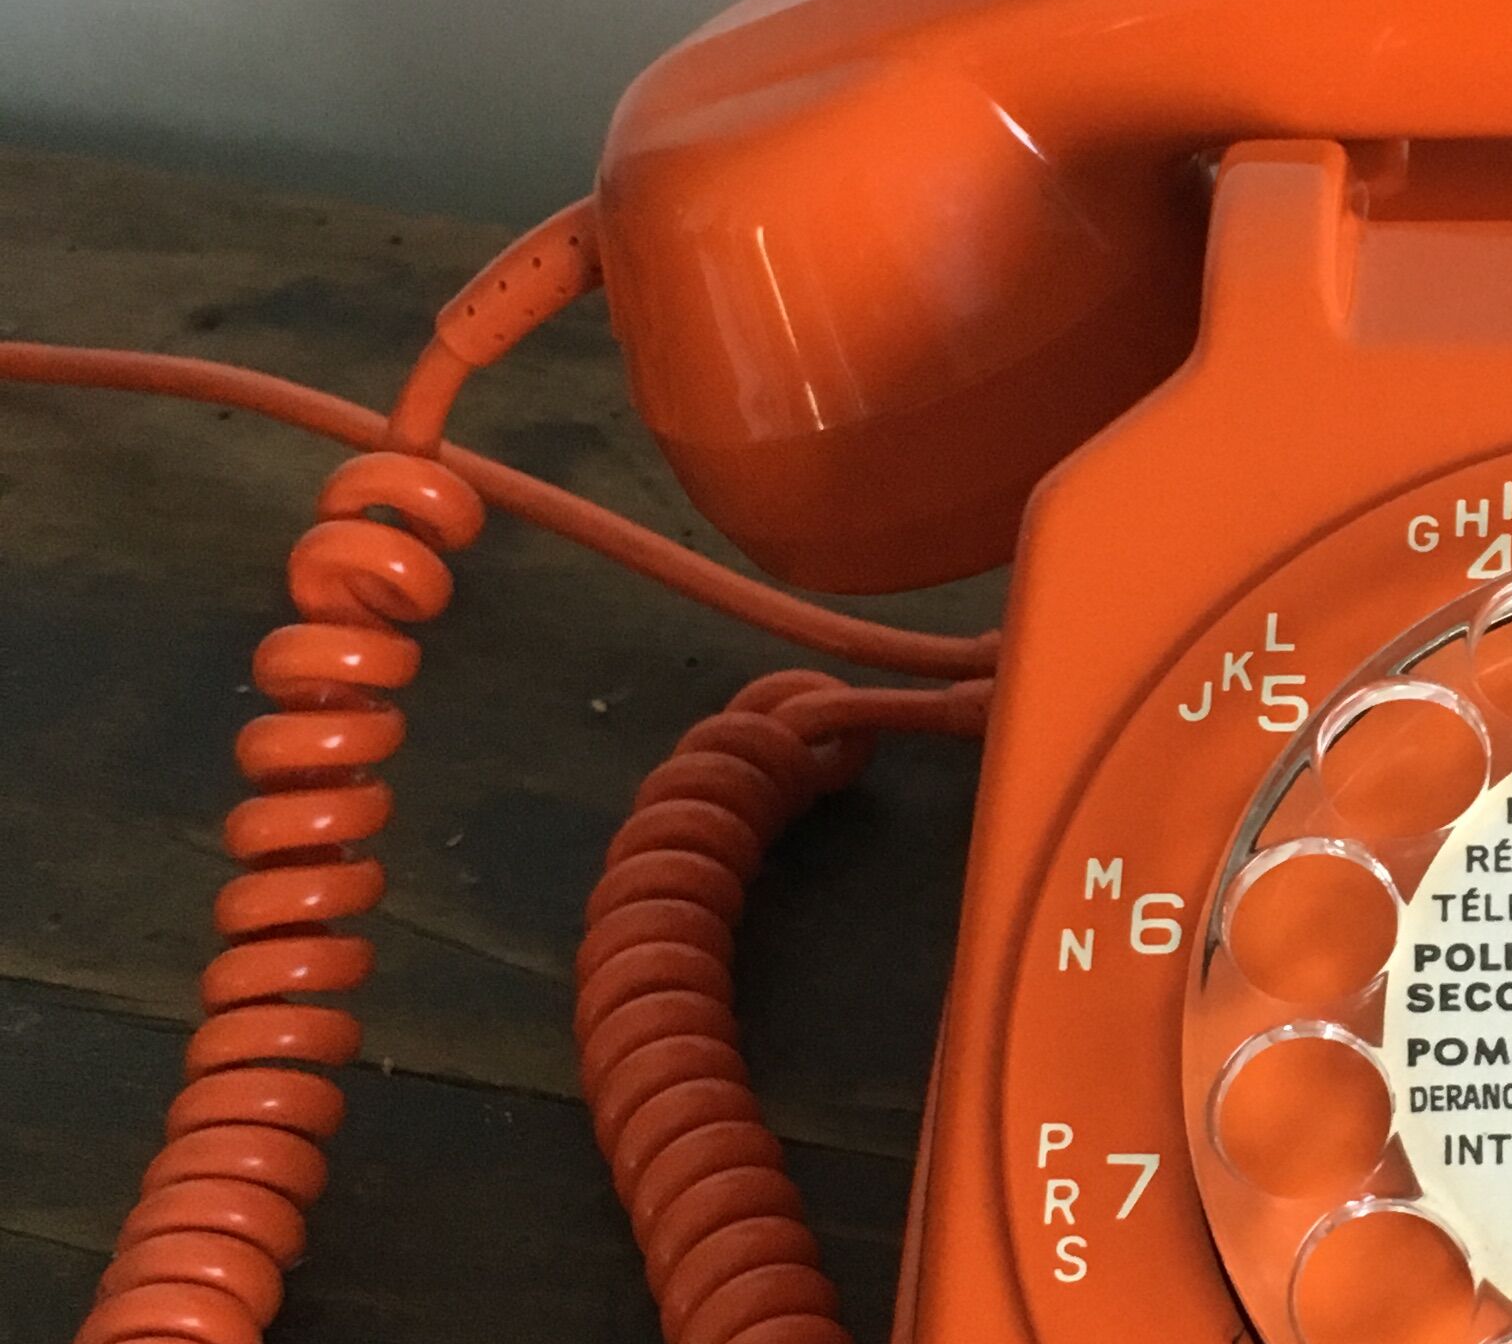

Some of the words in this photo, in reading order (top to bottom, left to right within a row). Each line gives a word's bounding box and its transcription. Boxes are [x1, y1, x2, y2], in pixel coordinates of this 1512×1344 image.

[1466, 533, 1512, 580] 4
[1257, 674, 1310, 733] 5
[1129, 892, 1186, 956] 6
[1105, 1152, 1161, 1221] 7
